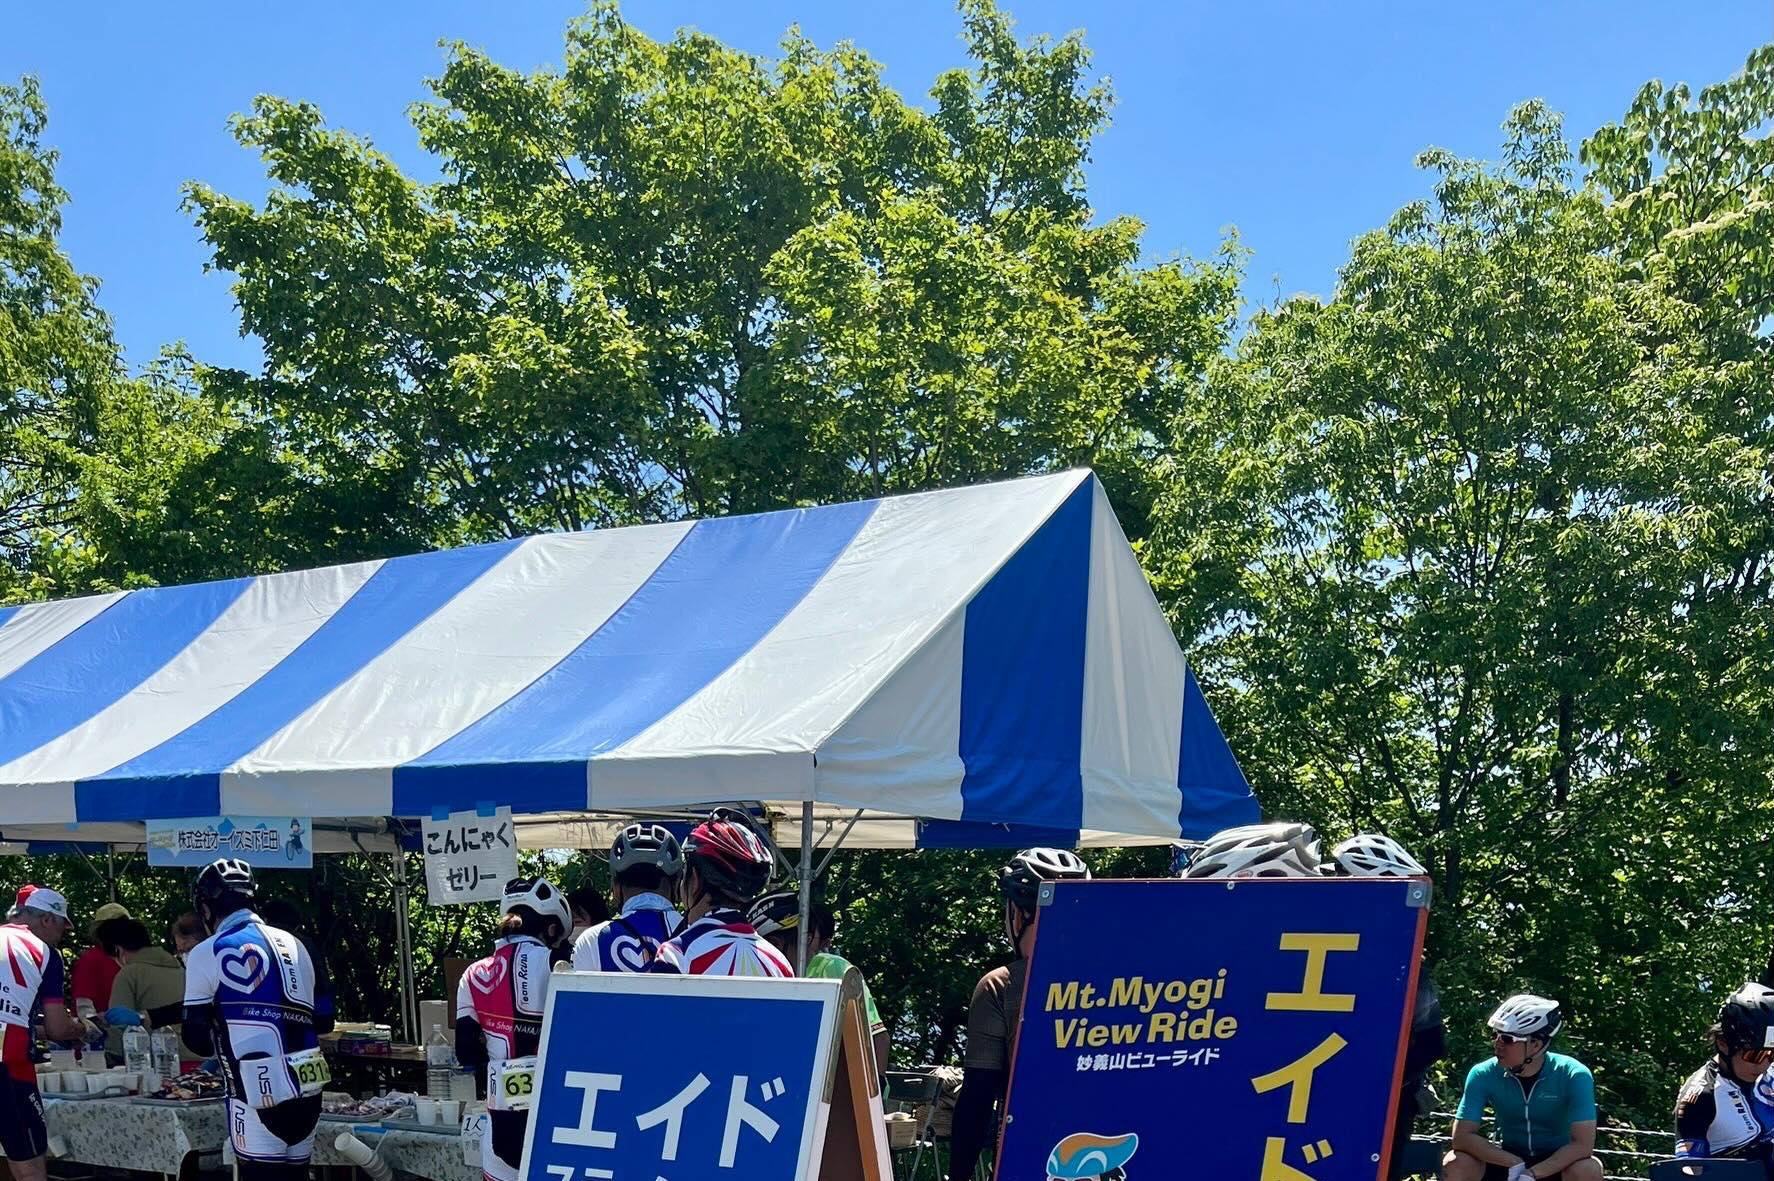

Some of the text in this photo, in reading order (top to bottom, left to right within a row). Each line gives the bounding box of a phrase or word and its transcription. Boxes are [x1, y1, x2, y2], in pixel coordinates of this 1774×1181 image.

[427, 822, 510, 855] こんにゃく
[446, 865, 497, 891] ゼリー
[1044, 967, 1228, 1014] Mt.Myogi
[1054, 1008, 1238, 1049] View Ride
[298, 1062, 325, 1084] 631
[1076, 1048, 1220, 1072] 妙義山ビューライド
[551, 1070, 786, 1168] エイド
